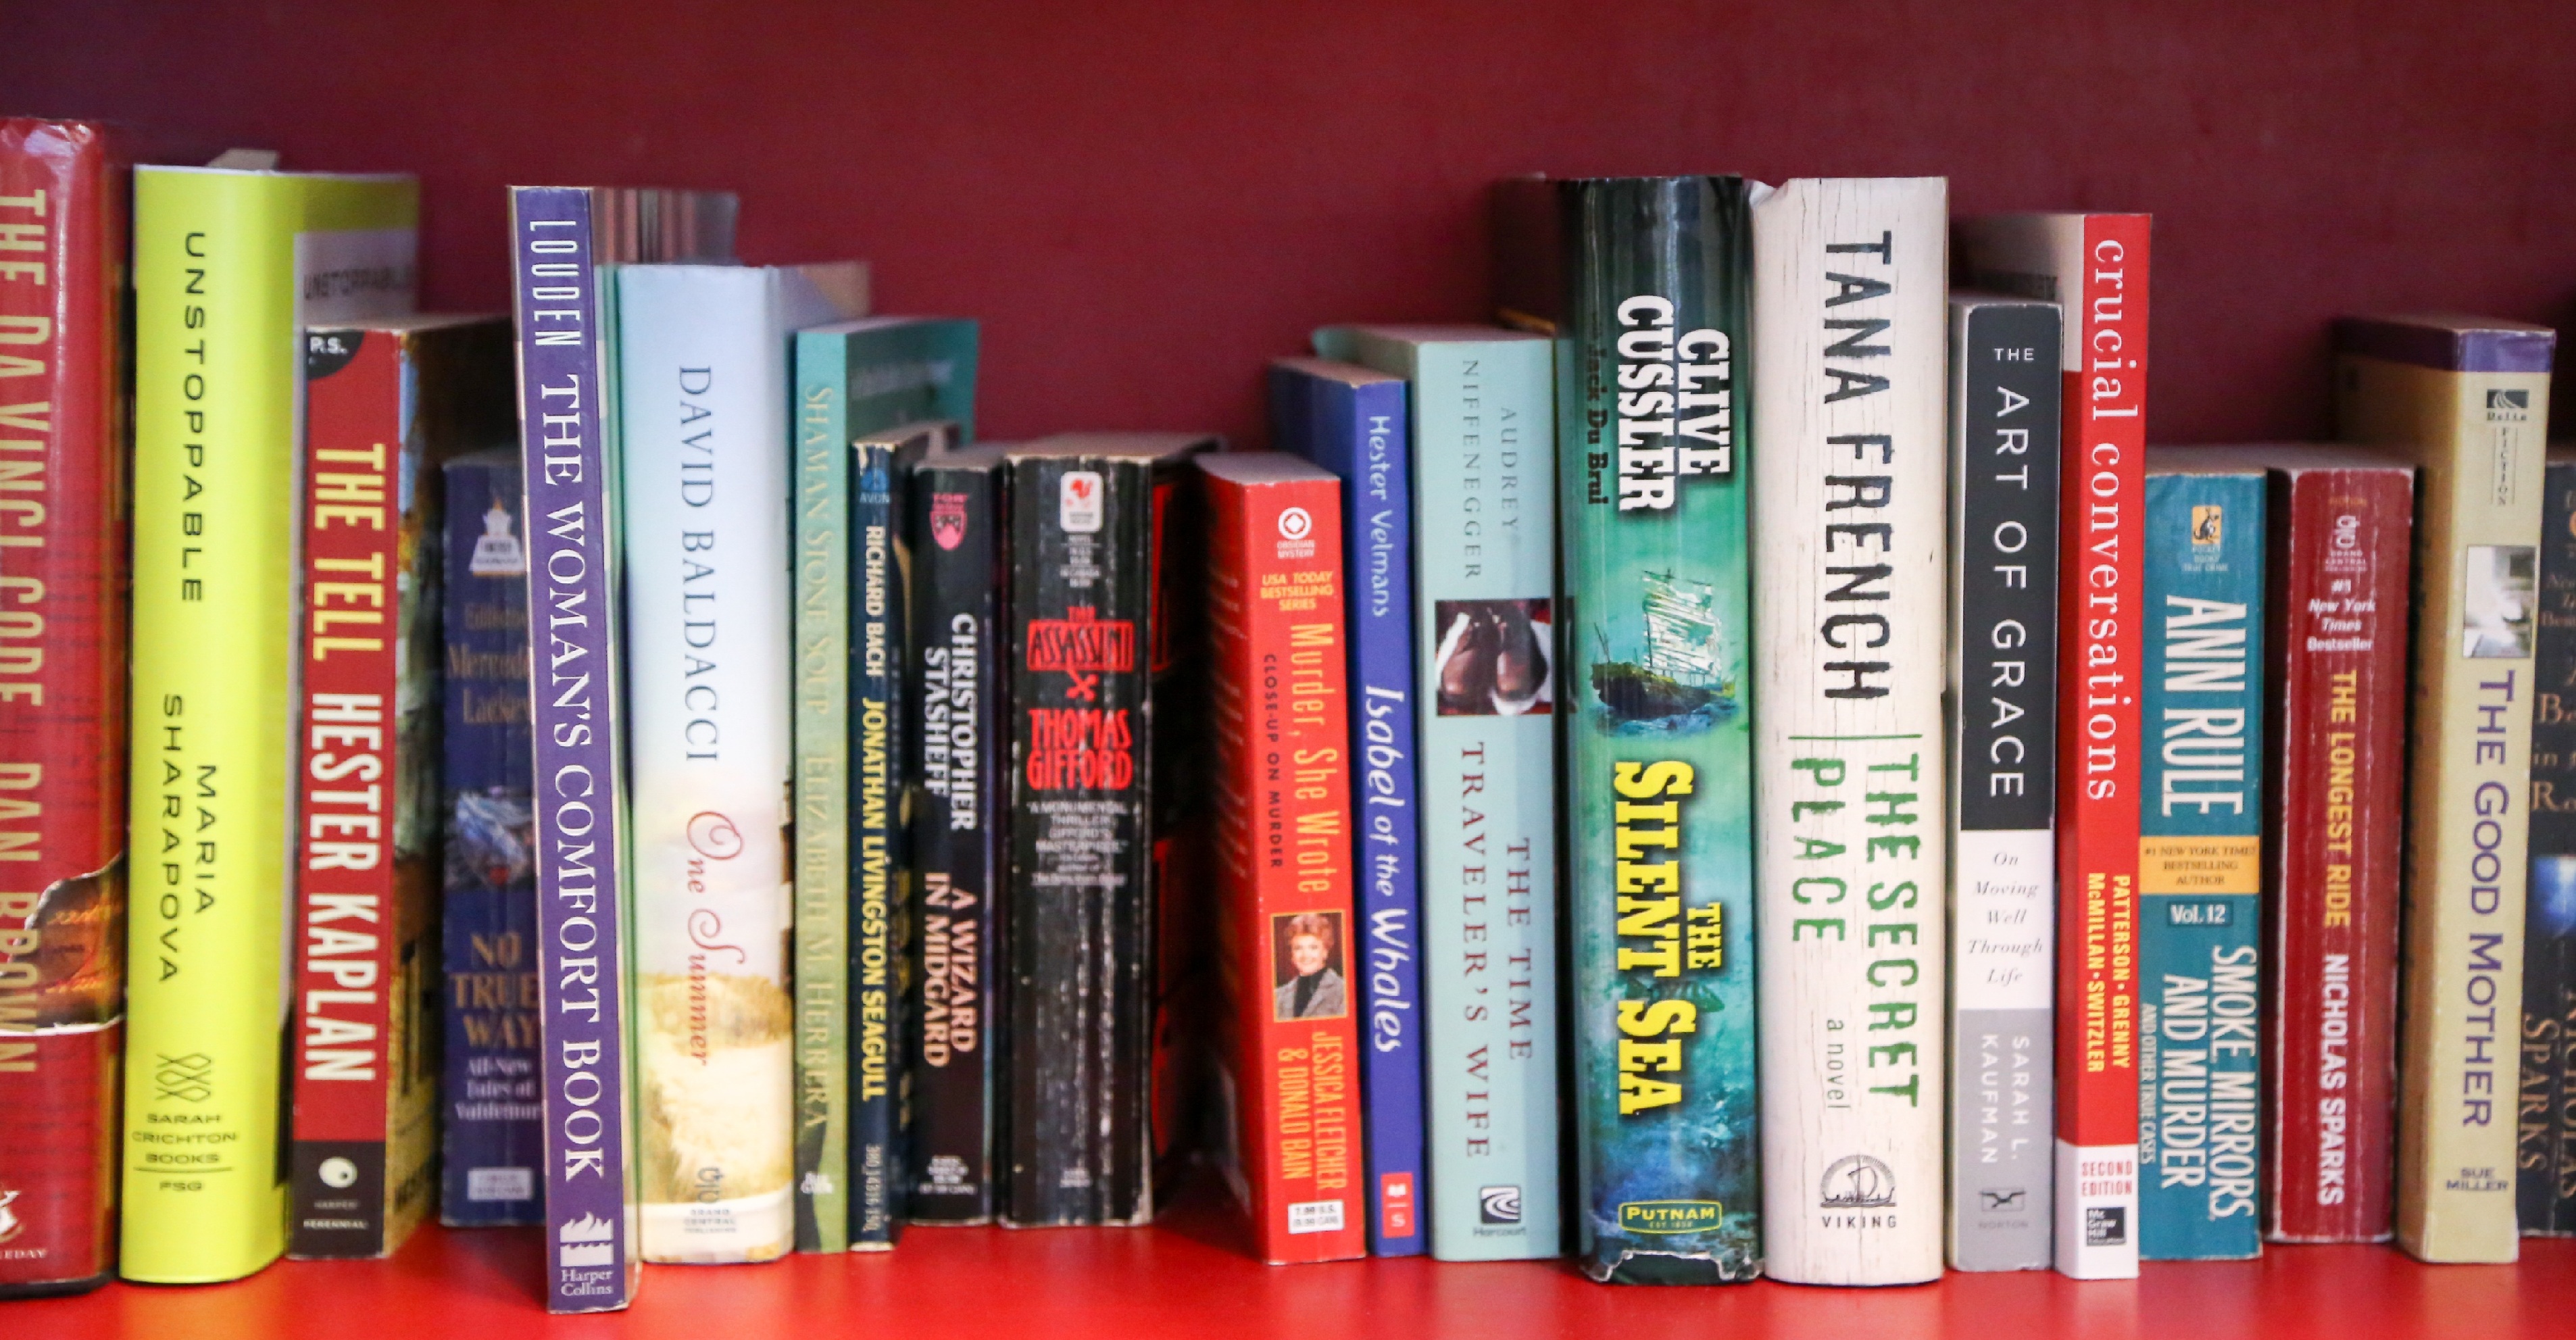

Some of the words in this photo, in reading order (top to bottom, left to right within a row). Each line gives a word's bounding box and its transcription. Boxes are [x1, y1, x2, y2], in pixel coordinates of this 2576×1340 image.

[0, 189, 46, 285] THE
[529, 220, 582, 347] LOUDEN
[1823, 230, 1892, 405] TANA
[0, 316, 51, 377] DA
[309, 336, 348, 355] P.S.
[1587, 344, 1608, 401] Jack
[1993, 348, 2035, 361] THE
[2092, 239, 2137, 420] crucial
[182, 232, 205, 602] UNSTOPPABLE
[541, 373, 583, 486] THE
[679, 366, 715, 508] DAVID
[1588, 408, 1608, 445] Du
[1617, 295, 1675, 512] CUSSLER
[1679, 329, 1730, 476] CLIVE
[1996, 387, 2030, 491] ART
[2487, 412, 2527, 421] Delta
[0, 401, 50, 548] VINCI
[314, 444, 385, 531] THE
[804, 386, 833, 518] SHAMAN
[1368, 416, 1391, 500] Hester
[1462, 359, 1481, 580] NIFFENEGGER
[1500, 407, 1518, 531] AUDREY
[1589, 452, 1609, 504] Brul
[860, 493, 890, 504] AVON
[804, 530, 833, 630] STONE
[865, 525, 886, 616] RICHARD
[1260, 585, 1333, 599] BESTSELLING
[1262, 574, 1287, 585] USA
[1293, 571, 1333, 583] TODAY
[1371, 509, 1391, 617] Velmans
[1822, 435, 1894, 699] FRENCH
[1993, 520, 2028, 590] OF
[2332, 579, 2352, 593] #1
[0, 576, 44, 706] CODE
[312, 553, 384, 662] TELL
[547, 501, 592, 748] WOMAN'S
[682, 530, 720, 762] BALDACCI
[1279, 598, 1316, 610] SERIES
[2087, 443, 2131, 798] conversations
[2164, 595, 2248, 693] ANN
[2307, 636, 2373, 651] Bestseller
[2308, 598, 2339, 613] New
[2344, 597, 2376, 612] York
[2321, 617, 2362, 631] Times
[804, 637, 833, 715] SOUP
[865, 622, 886, 677] BACH
[1289, 622, 1335, 737] Murder,
[924, 646, 950, 797] STASHEFF
[951, 612, 977, 832] CHRISTOPHER
[1027, 708, 1133, 748] THOMAS
[1264, 654, 1279, 743] CLOSE-UP
[1990, 618, 2027, 797] GRACE
[2331, 671, 2356, 723] THE
[2477, 671, 2515, 766] THE
[309, 693, 382, 871] HESTER
[862, 697, 887, 828] JONATHAN
[1026, 749, 1133, 790] GIFFORD
[1268, 753, 1279, 780] ON
[1294, 747, 1338, 799] She
[1366, 684, 1405, 807] Isabel
[2163, 708, 2246, 817] RULE
[1268, 788, 1283, 868] MURDER
[1370, 816, 1392, 849] of
[1866, 753, 1921, 863] THE
[2327, 733, 2354, 854] LONGEST
[159, 694, 184, 983] SHARAPOVA
[194, 764, 218, 916] MARIA
[687, 810, 743, 895] One
[804, 757, 836, 922] ELIZABETH
[1297, 810, 1339, 893] Wrote
[1377, 853, 1400, 897] the
[1462, 741, 1489, 1022] TRAVELER'S
[1614, 760, 1693, 977] SILENT
[1790, 757, 1848, 943] PLACE
[1993, 852, 2018, 866] On
[2160, 847, 2185, 855] NEW
[2189, 847, 2219, 855] YORK
[2164, 861, 2238, 870] BESTSELLING
[2176, 876, 2225, 885] AUTHOR
[2471, 784, 2510, 916] GOOD
[555, 764, 600, 1024] COMFORT
[862, 835, 887, 986] LIVINGSTON
[924, 872, 951, 906] IN
[950, 887, 978, 910] A
[1507, 837, 1531, 927] THE
[1973, 881, 2039, 898] Moving
[1987, 909, 2027, 924] Well
[2087, 872, 2105, 970] McMILLAN
[2171, 904, 2204, 924] Vol.
[2207, 904, 2225, 924] 12
[2325, 862, 2352, 926] RIDE
[471, 931, 522, 969] NO
[804, 937, 835, 968] M.
[1687, 902, 1722, 969] THE
[1968, 938, 2043, 958] Through
[2112, 875, 2131, 981] PATTERSON
[305, 894, 379, 1081] KAPLAN
[451, 972, 539, 1010] TRUE
[687, 908, 745, 1067] Summer
[924, 912, 951, 1067] MIDGARD
[950, 919, 978, 1052] WIZARD
[1370, 909, 1410, 1052] Whales
[1508, 948, 1532, 1060] TIME
[1868, 880, 1921, 1108] SECRET
[1986, 967, 2023, 987] Life
[2163, 974, 2208, 1041] AND
[462, 1014, 538, 1049] WAY
[804, 982, 836, 1128] HERRERA
[862, 993, 887, 1102] SEAGULL
[1278, 1047, 1309, 1062] &
[1618, 999, 1696, 1115] SEA
[1827, 1020, 1845, 1031] a
[2087, 982, 2105, 1072] SWITZLER
[2112, 995, 2131, 1067] GRENNY
[2321, 955, 2349, 1090] NICHOLAS
[2462, 934, 2504, 1128] MOTHER
[562, 1039, 604, 1182] BOOK
[1278, 1067, 1311, 1134] DONALD
[1311, 1031, 1344, 1104] JESSICA
[1466, 1045, 1489, 1157] WIFE
[1827, 1042, 1850, 1110] novel
[1981, 1034, 1998, 1164] KAUFMAN
[2012, 1036, 2030, 1128] SARAH
[2519, 1014, 2561, 1170] SPARKS
[132, 1131, 237, 1144] CRICHTON
[145, 1153, 220, 1164] BOOKS
[147, 1114, 221, 1124] SARAH
[1281, 1138, 1312, 1180] BAIN
[1314, 1107, 1347, 1190] FLETCHER
[2011, 1135, 2030, 1160] L.
[2160, 1049, 2208, 1189] MURDER
[2319, 1097, 2346, 1206] SPARKS
[159, 1181, 203, 1191] FSG
[2081, 1161, 2133, 1176] SECOND
[2081, 1181, 2133, 1196] EDITION
[2446, 1179, 2509, 1191] MILLER
[2461, 1168, 2493, 1178] SUE
[1472, 1226, 1526, 1237] Harcourt
[1627, 1207, 1715, 1221] PUTNAM
[1823, 1216, 1898, 1229] VIKING
[561, 1269, 613, 1284] Harper
[561, 1282, 613, 1296] Collins
